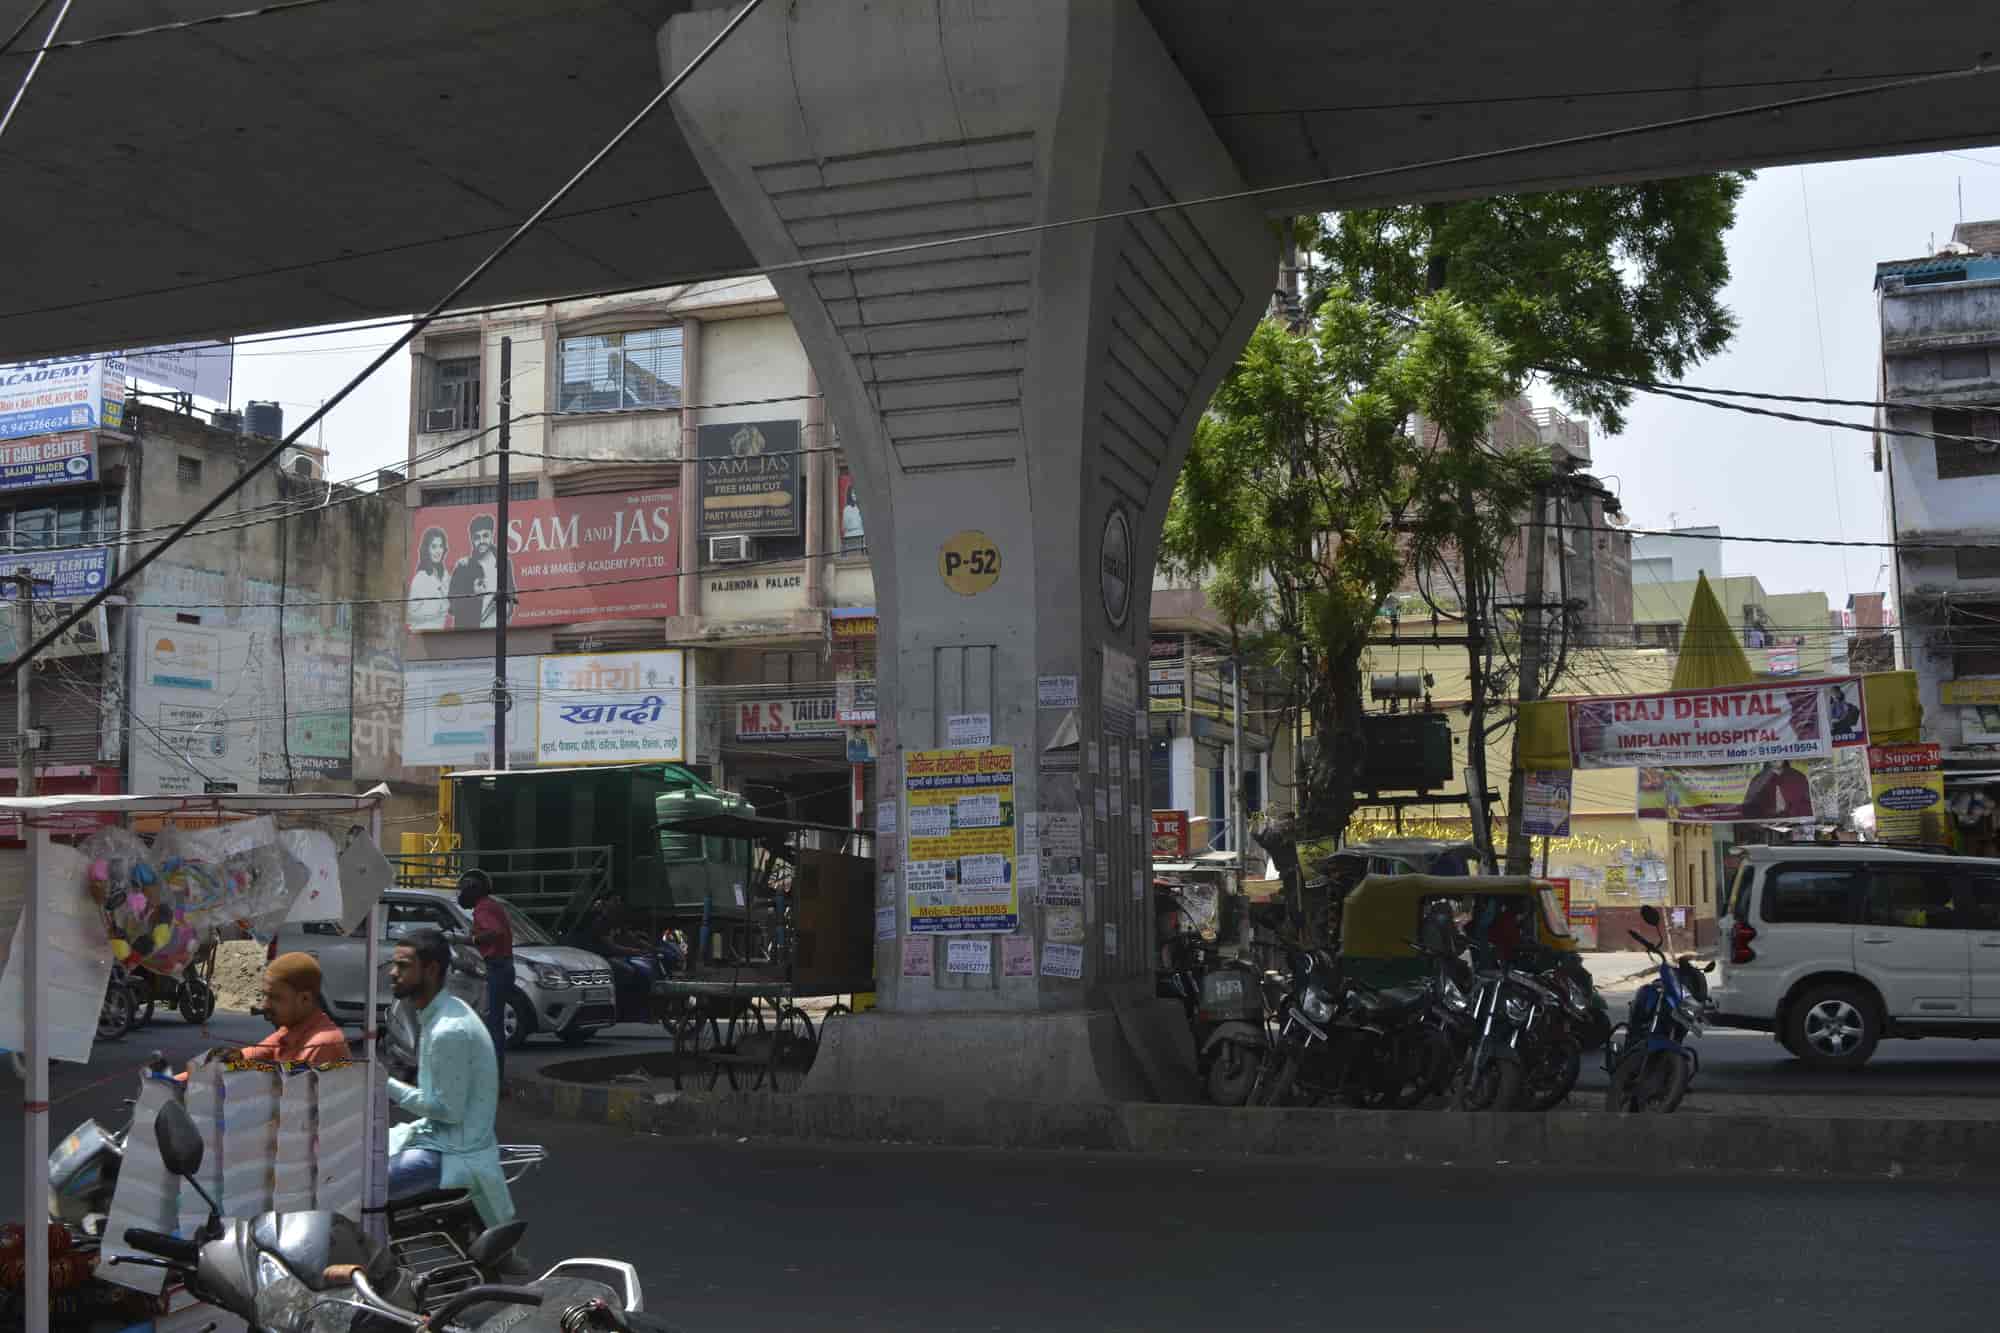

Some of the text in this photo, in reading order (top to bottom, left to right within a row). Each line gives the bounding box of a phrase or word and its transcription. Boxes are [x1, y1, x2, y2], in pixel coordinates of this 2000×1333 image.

[43, 440, 86, 458] CENTRE
[507, 506, 671, 553] SAM AND JAS
[521, 566, 541, 577] HAIR
[550, 563, 586, 575] MAKEUP
[587, 559, 627, 571] ACADEMY
[944, 549, 997, 577] P-52
[711, 576, 801, 592] RAJENDRA PALACE
[559, 695, 667, 725] खादी
[741, 703, 790, 733] M.S.
[1614, 692, 1782, 722] RAJ DENTAL
[1617, 728, 1780, 750] IMPLANT HOSPITAL
